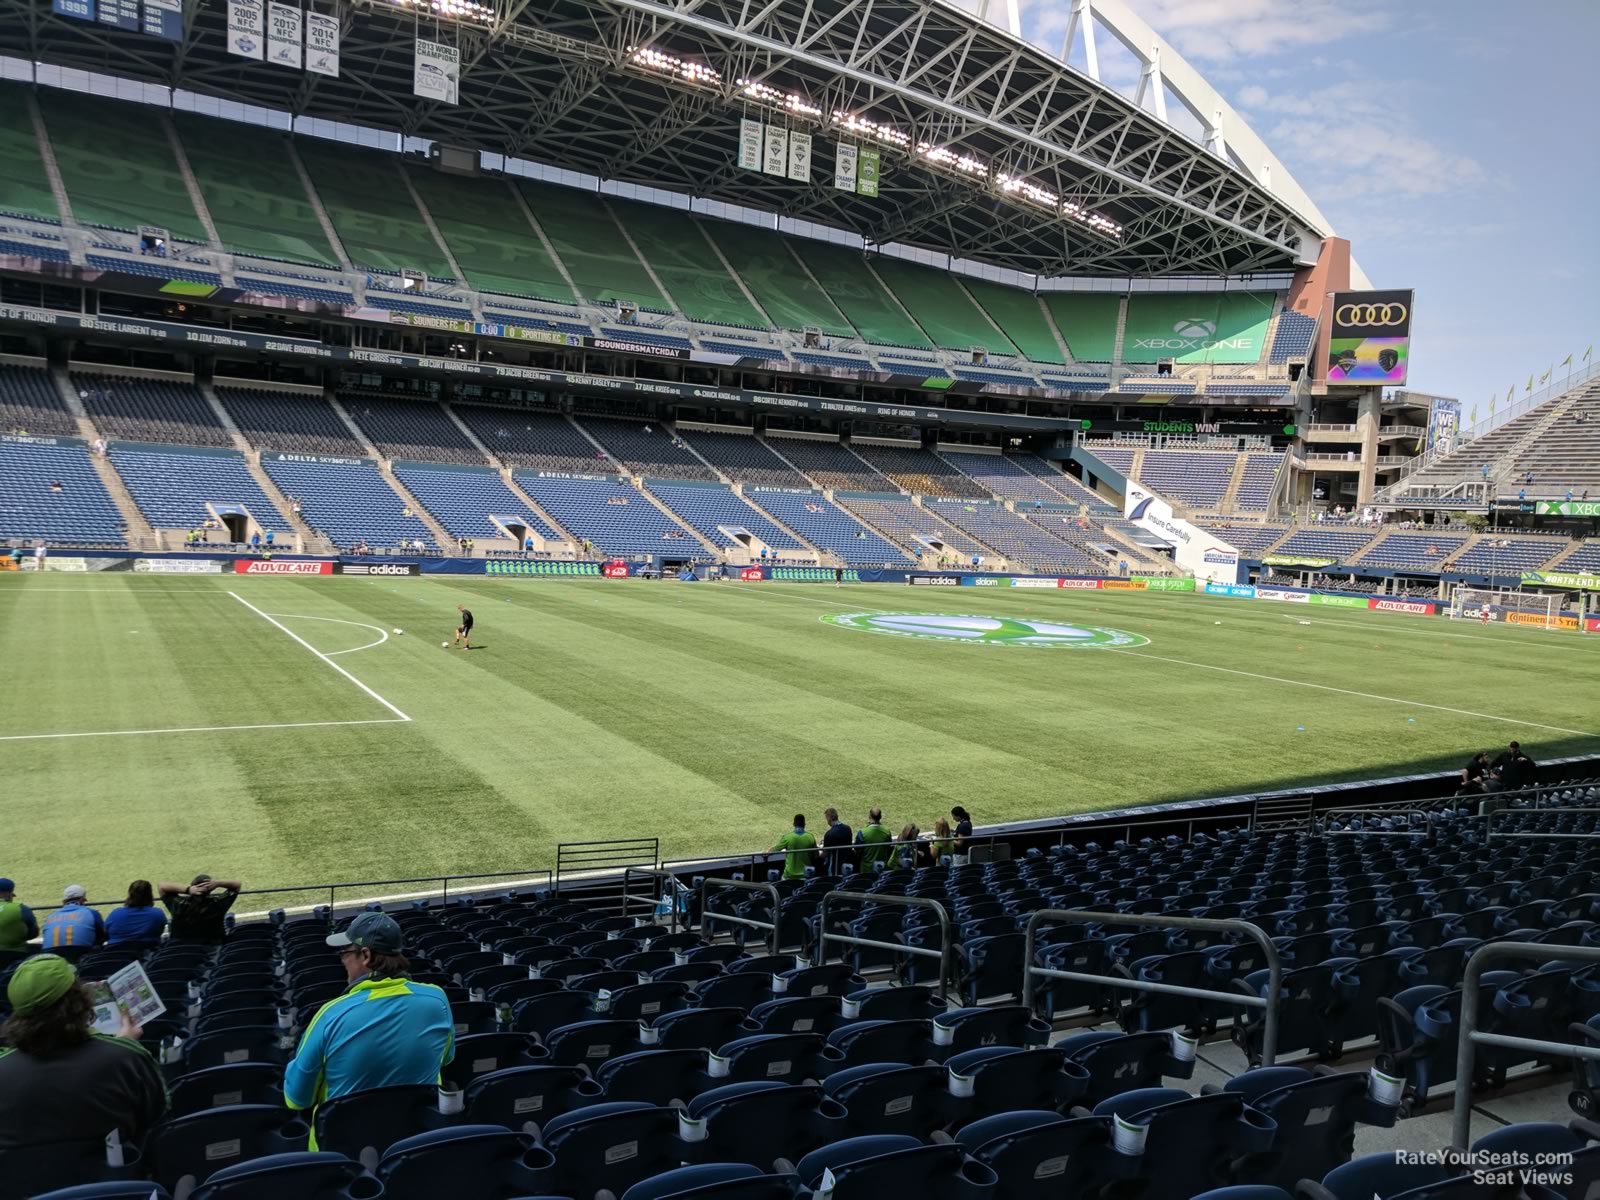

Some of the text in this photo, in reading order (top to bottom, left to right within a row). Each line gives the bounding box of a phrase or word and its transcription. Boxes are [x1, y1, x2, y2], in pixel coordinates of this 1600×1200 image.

[60, 2, 88, 15] 1999
[120, 1, 137, 10] 2007
[145, 6, 162, 16] 2013
[234, 7, 257, 20] 2005
[145, 16, 162, 25] 2014
[237, 18, 254, 28] NFC
[273, 18, 297, 31] 2013
[229, 24, 263, 37] CHAMPIONS
[276, 28, 293, 38] NFC
[312, 27, 334, 40] 2014
[268, 34, 301, 47] CHAMPIONS
[315, 37, 331, 47] NFC
[307, 43, 338, 56] CHAMPIONS
[417, 41, 457, 57] 2013 WORLD
[417, 48, 457, 63] CHAMPIONS
[768, 130, 786, 140] CHAMPS
[792, 136, 810, 146] CHAMPS
[838, 149, 856, 158] SHIELD
[769, 157, 781, 166] 2009
[794, 163, 805, 171] 2011
[769, 164, 781, 173] 2010
[793, 169, 805, 178] 2014
[836, 175, 855, 184] CHAMPS
[9, 309, 21, 320] OF
[24, 311, 56, 324] HONOR
[80, 319, 94, 329] 80
[95, 321, 117, 331] STEVE
[118, 323, 150, 336] LARGENT
[413, 316, 469, 332] SOUNDERS FC 0
[481, 324, 498, 335] 0:00
[186, 332, 198, 340] 10
[200, 334, 213, 343] JIM
[214, 335, 231, 345] ZORN
[509, 328, 561, 343] 0 SPORTING KC
[265, 341, 278, 350] 22
[278, 343, 293, 352] DAVE
[294, 345, 317, 355] BROWN
[594, 340, 680, 357] #SOUNDERSMATCHDAY
[1132, 338, 1254, 350] XBOX ONE
[354, 350, 369, 360] PETE
[370, 352, 390, 363] GROSS
[429, 360, 443, 369] CURT
[444, 362, 468, 372] WARNER
[496, 367, 504, 375] 79
[505, 368, 521, 377] JACOB
[522, 369, 540, 379] GREEN
[566, 375, 576, 383] 45
[575, 376, 592, 385] KENNY
[592, 378, 610, 387] EASLEY
[643, 383, 654, 392] DAVE
[655, 385, 670, 393] KRIEG
[702, 390, 717, 399] CHUCK
[718, 392, 730, 400] KNOX
[762, 397, 778, 405] CORTEZ
[778, 398, 799, 407] KENNEDY
[828, 403, 843, 411] WALTER
[1438, 412, 1453, 427] WE
[1143, 422, 1220, 433] STUDENTS WIN!
[287, 454, 317, 462] DELTA
[1147, 512, 1191, 544] Insure Carefully
[249, 562, 320, 573] ADVOCARE
[369, 565, 409, 574] adidas
[931, 577, 956, 585] adidas
[975, 578, 998, 586] slalom
[1063, 580, 1096, 588] ADVOCARE
[1104, 581, 1130, 589] Continental
[1545, 575, 1574, 585] NORTH
[1576, 578, 1594, 587] END
[1377, 601, 1425, 613] ADVOCARE
[53, 925, 73, 946] 11
[1577, 1097, 1587, 1110] M
